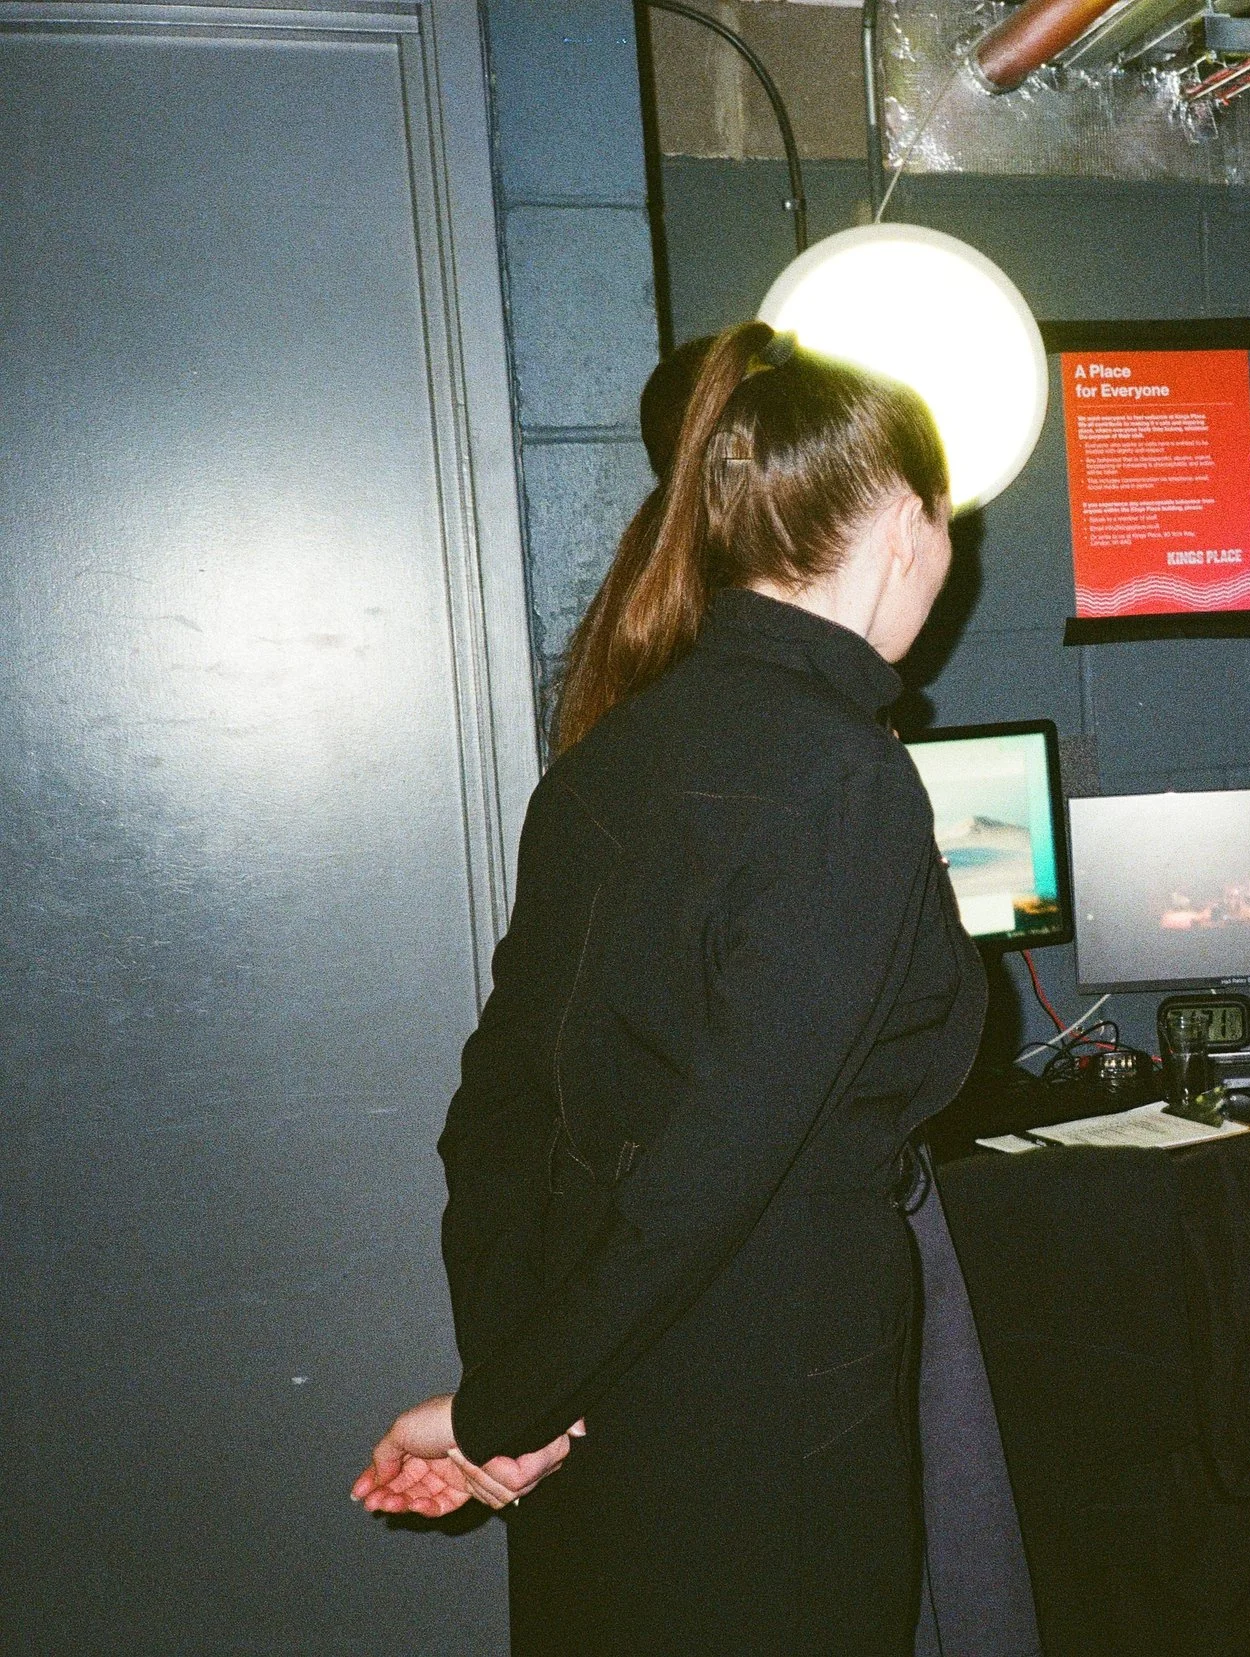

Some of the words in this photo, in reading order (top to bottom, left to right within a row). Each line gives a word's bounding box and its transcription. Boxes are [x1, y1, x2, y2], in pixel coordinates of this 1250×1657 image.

[1075, 364, 1086, 378] A
[1089, 364, 1131, 378] Place
[1075, 384, 1097, 398] for
[1100, 383, 1170, 400] Everyone
[1167, 550, 1203, 565] KINGS
[1206, 549, 1242, 564] PLACE
